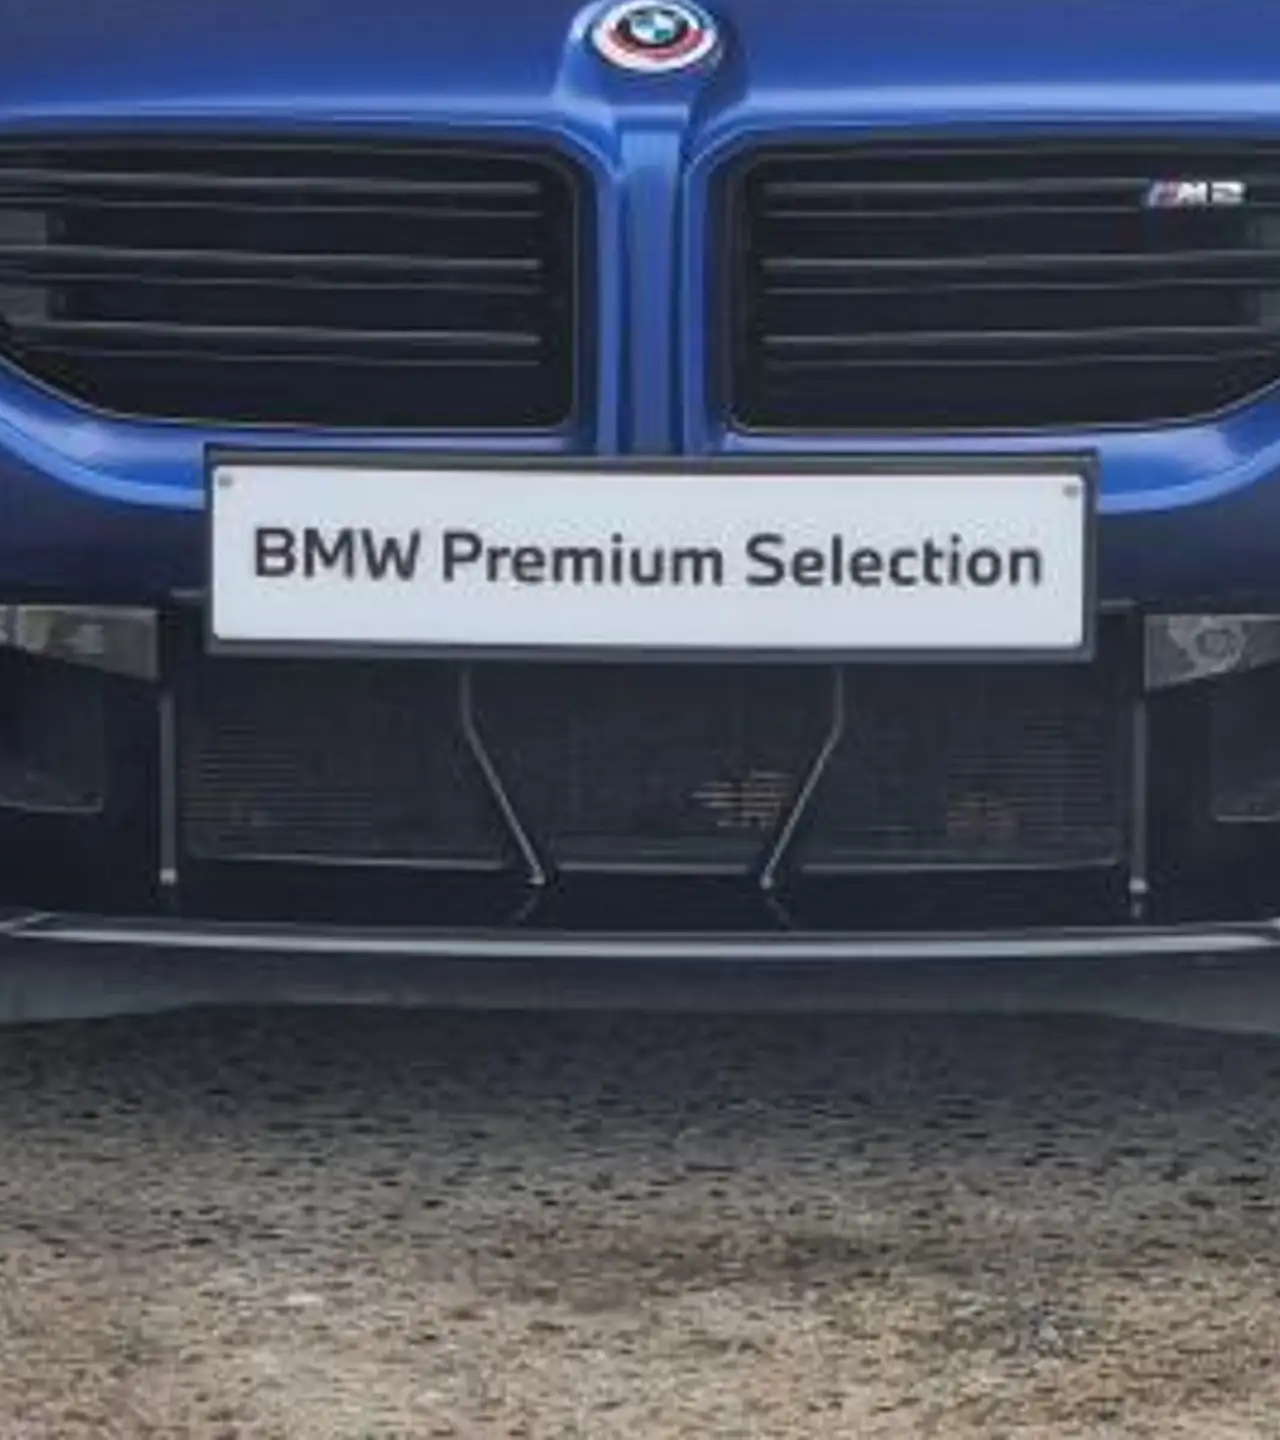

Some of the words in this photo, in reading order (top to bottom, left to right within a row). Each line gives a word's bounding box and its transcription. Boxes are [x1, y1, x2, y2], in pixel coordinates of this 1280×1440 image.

[253, 525, 422, 582] BMW
[441, 529, 725, 588] Premium
[745, 531, 1043, 589] Selection
